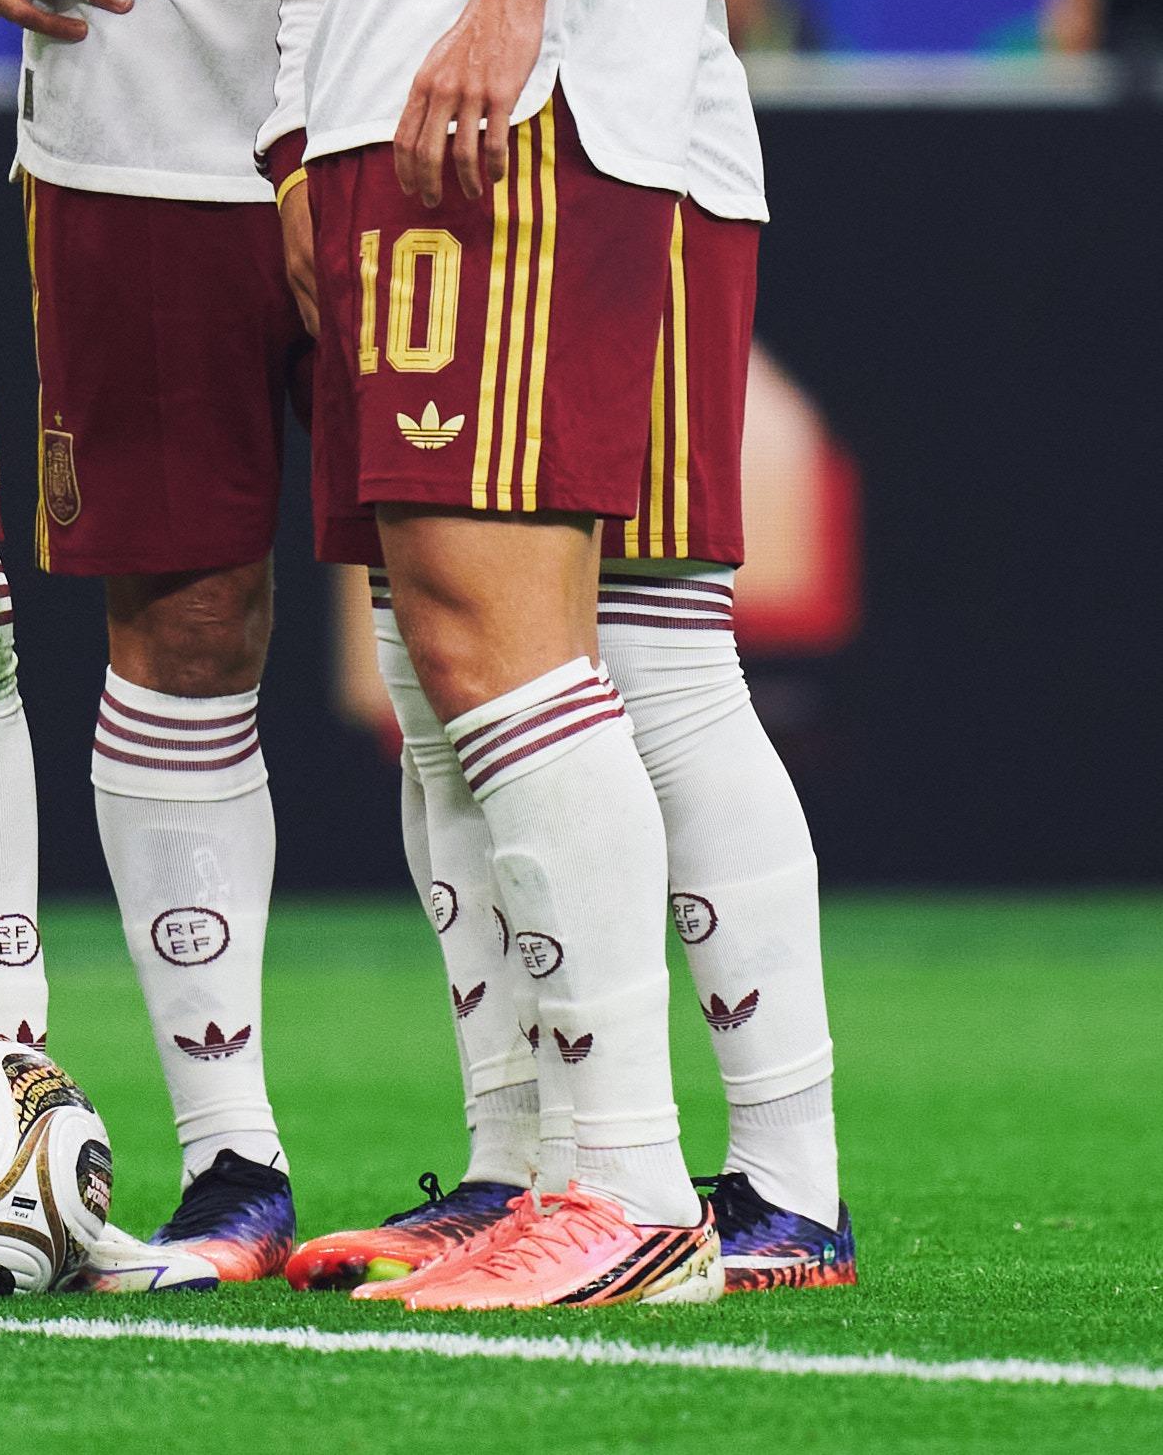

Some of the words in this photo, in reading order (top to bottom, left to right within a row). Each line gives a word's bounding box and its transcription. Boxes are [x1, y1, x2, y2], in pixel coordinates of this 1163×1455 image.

[358, 229, 462, 375] 10
[166, 919, 208, 937] RF
[0, 941, 29, 955] EF
[171, 937, 211, 955] EF
